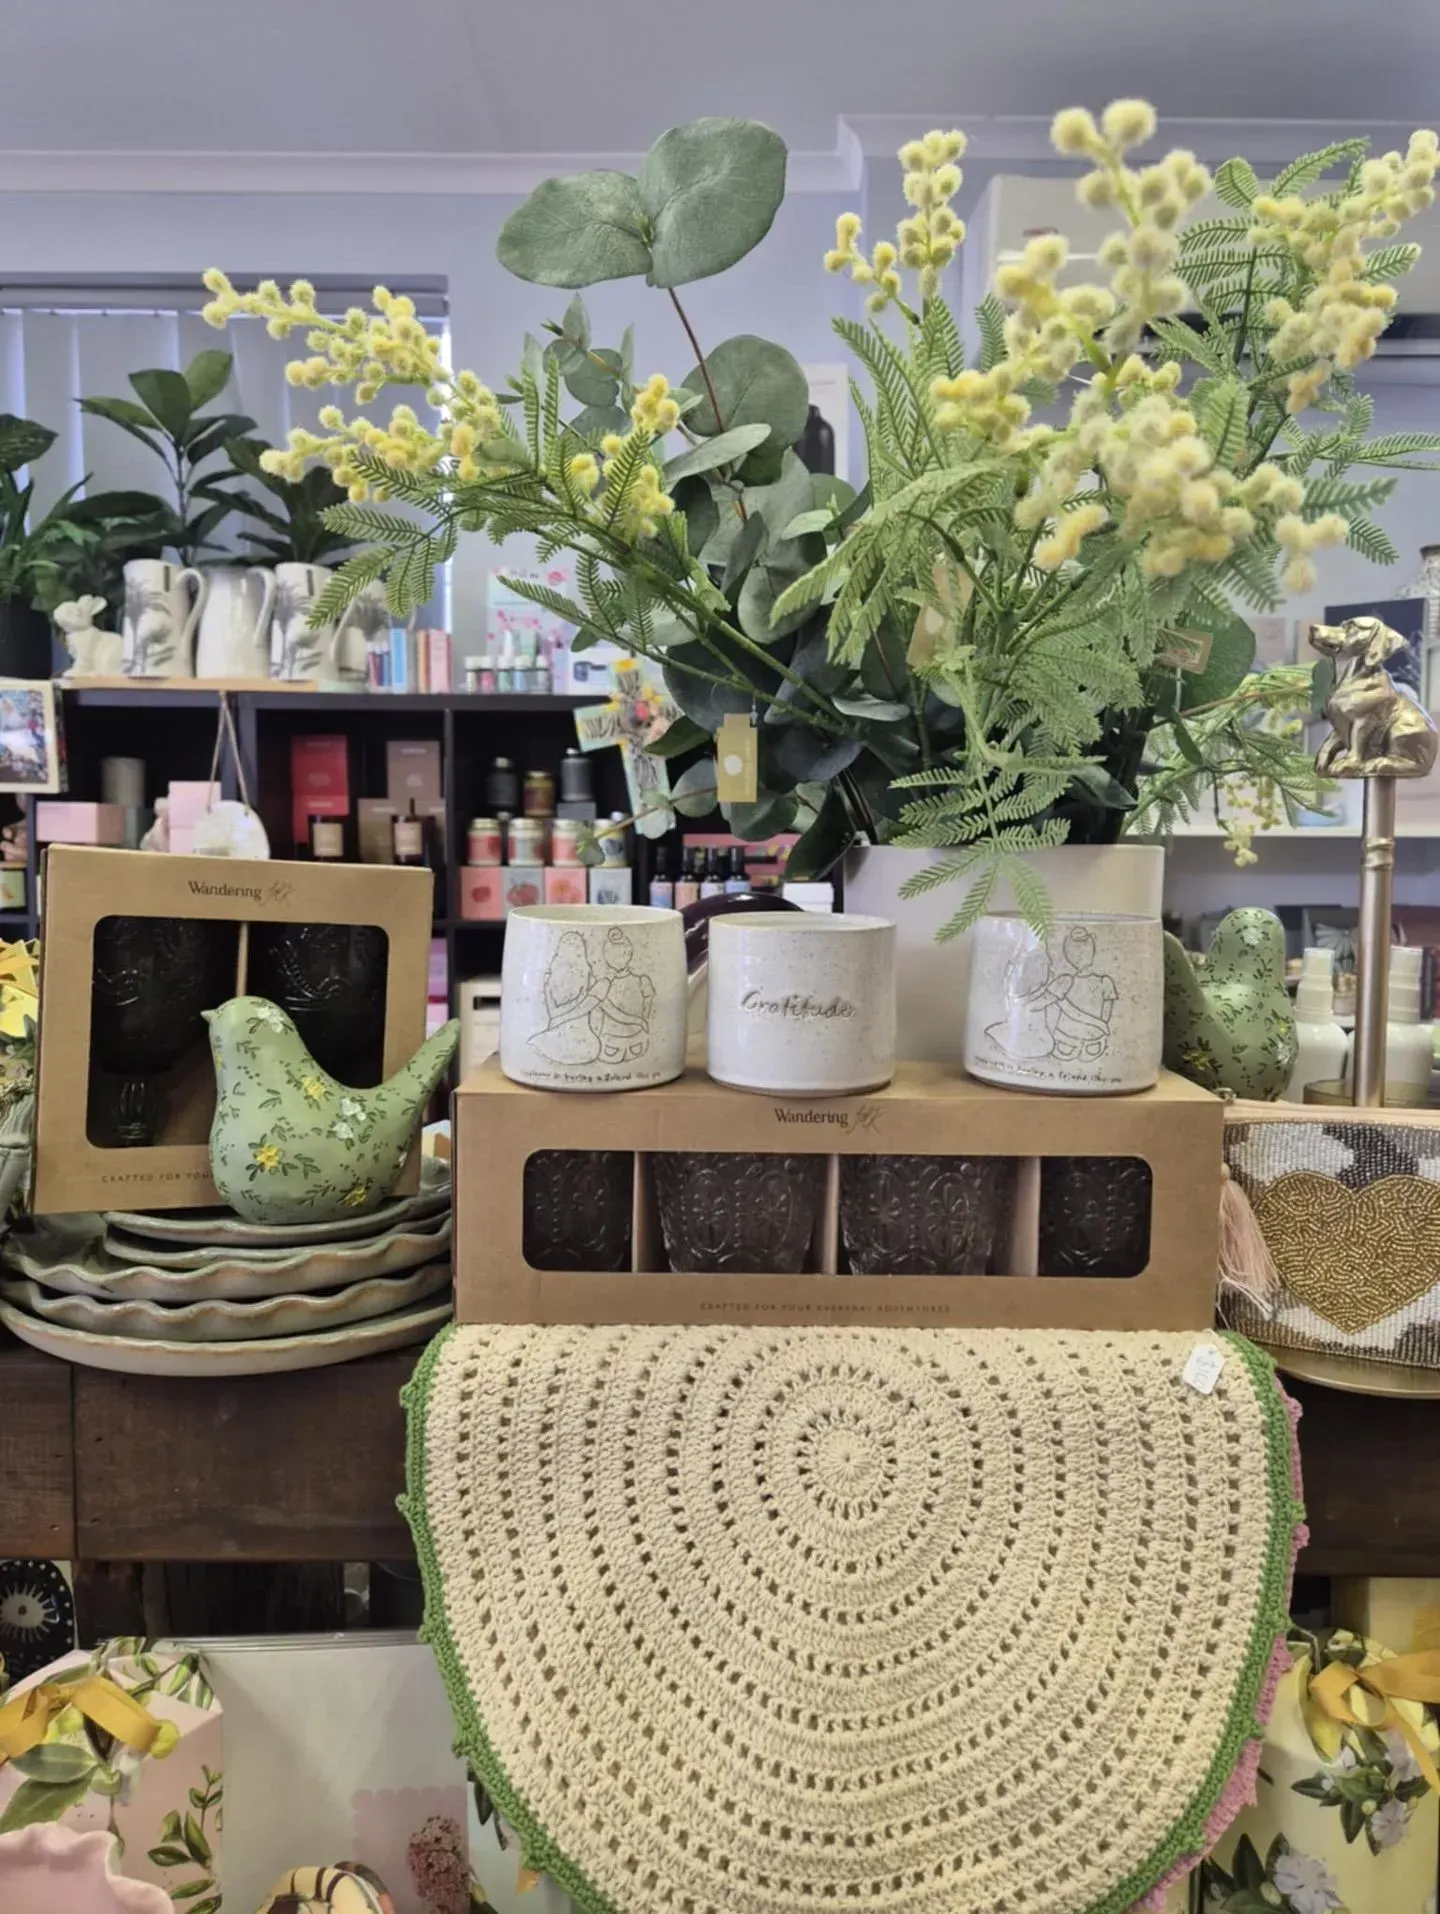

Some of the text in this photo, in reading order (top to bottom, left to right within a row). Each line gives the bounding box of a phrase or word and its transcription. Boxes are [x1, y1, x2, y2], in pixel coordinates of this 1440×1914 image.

[187, 880, 262, 901] Wandering
[741, 990, 855, 1019] Gratitude
[774, 1107, 849, 1129] Wandering
